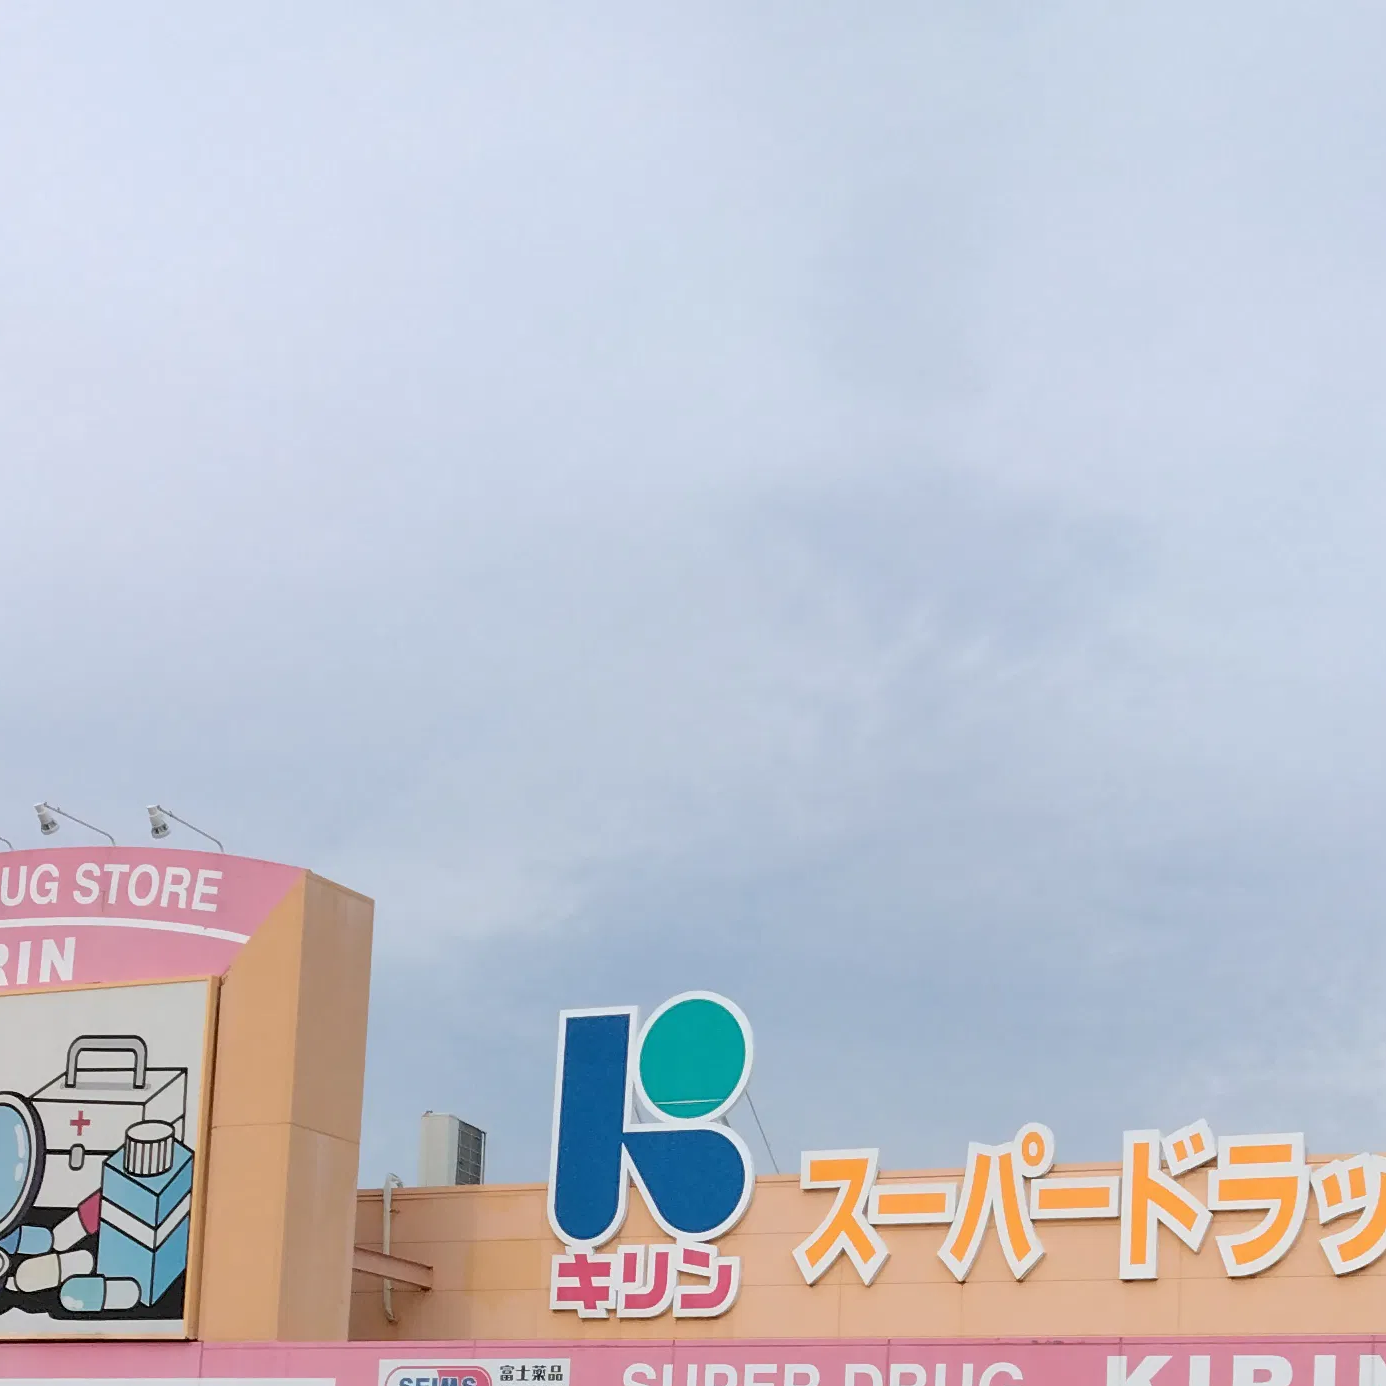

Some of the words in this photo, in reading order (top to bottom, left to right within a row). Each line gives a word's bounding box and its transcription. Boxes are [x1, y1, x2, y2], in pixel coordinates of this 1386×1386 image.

[74, 863, 224, 913] STORE
[551, 1247, 740, 1318] キリン
[499, 1365, 563, 1382] 富士薬品
